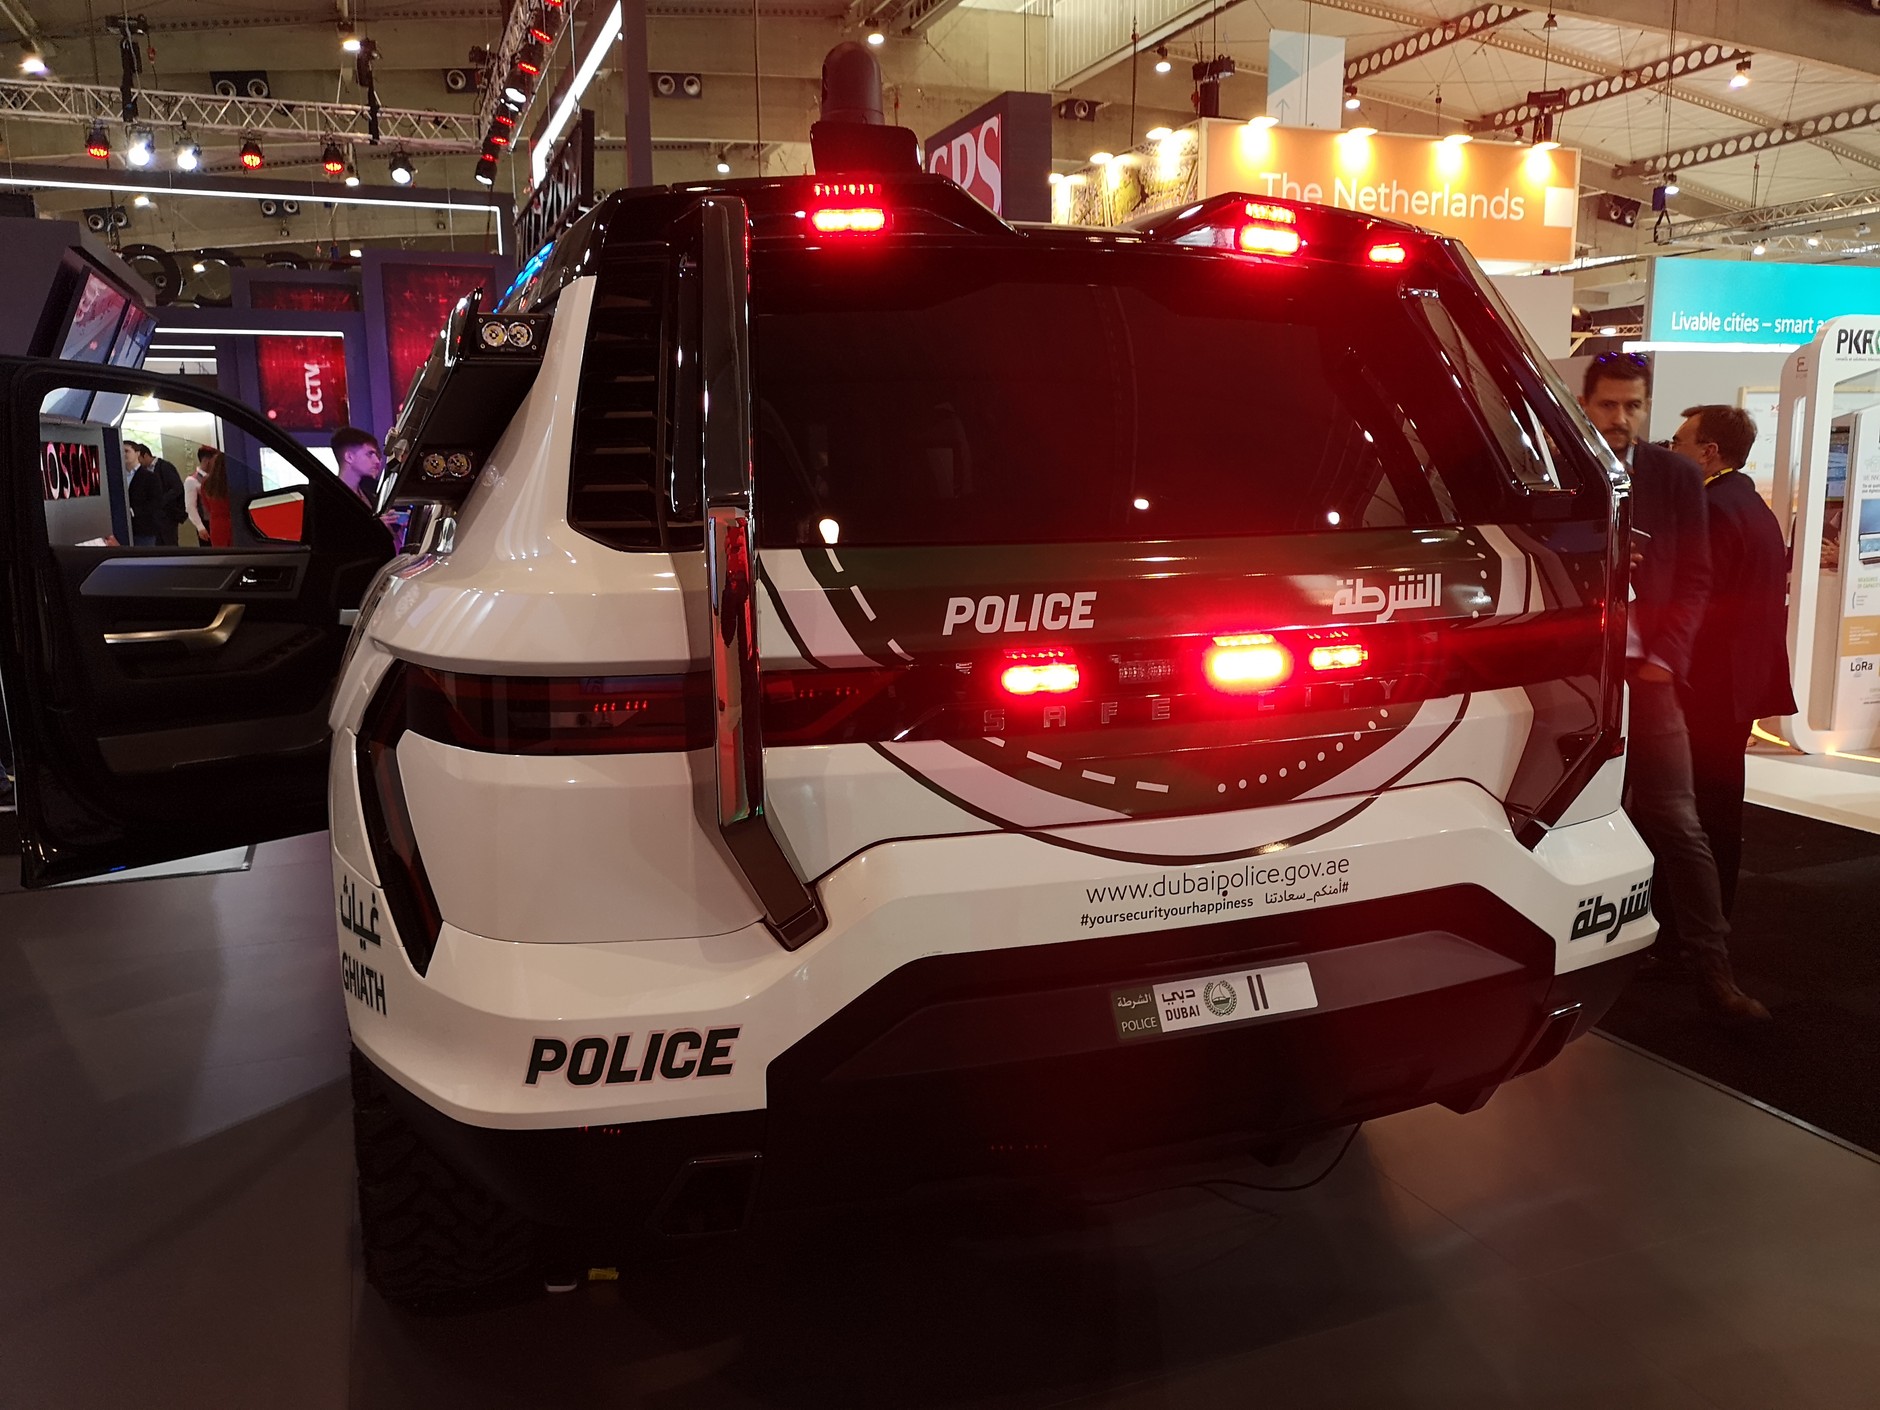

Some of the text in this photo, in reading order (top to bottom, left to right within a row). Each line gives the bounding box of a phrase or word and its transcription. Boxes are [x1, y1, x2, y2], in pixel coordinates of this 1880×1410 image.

[1259, 171, 1526, 222] The Netherlands
[1671, 310, 1721, 333] Livable
[1723, 312, 1759, 333] cities
[1774, 316, 1814, 334] smart
[304, 362, 323, 414] CCTV
[942, 591, 1097, 636] POLICE
[1332, 573, 1442, 622] الشرطة
[983, 697, 1171, 732] SAFE
[1086, 858, 1350, 904] www.dubaipolice.gov.ae
[1080, 896, 1254, 928] #yoursecurityourhappiness
[342, 951, 387, 1016] GHIATH
[1117, 993, 1152, 1009] الشرطة
[1161, 989, 1196, 1006] دبي
[1121, 1017, 1157, 1032] POLICE
[1165, 1005, 1200, 1022] DUBAI
[523, 1026, 742, 1087] POLICE
